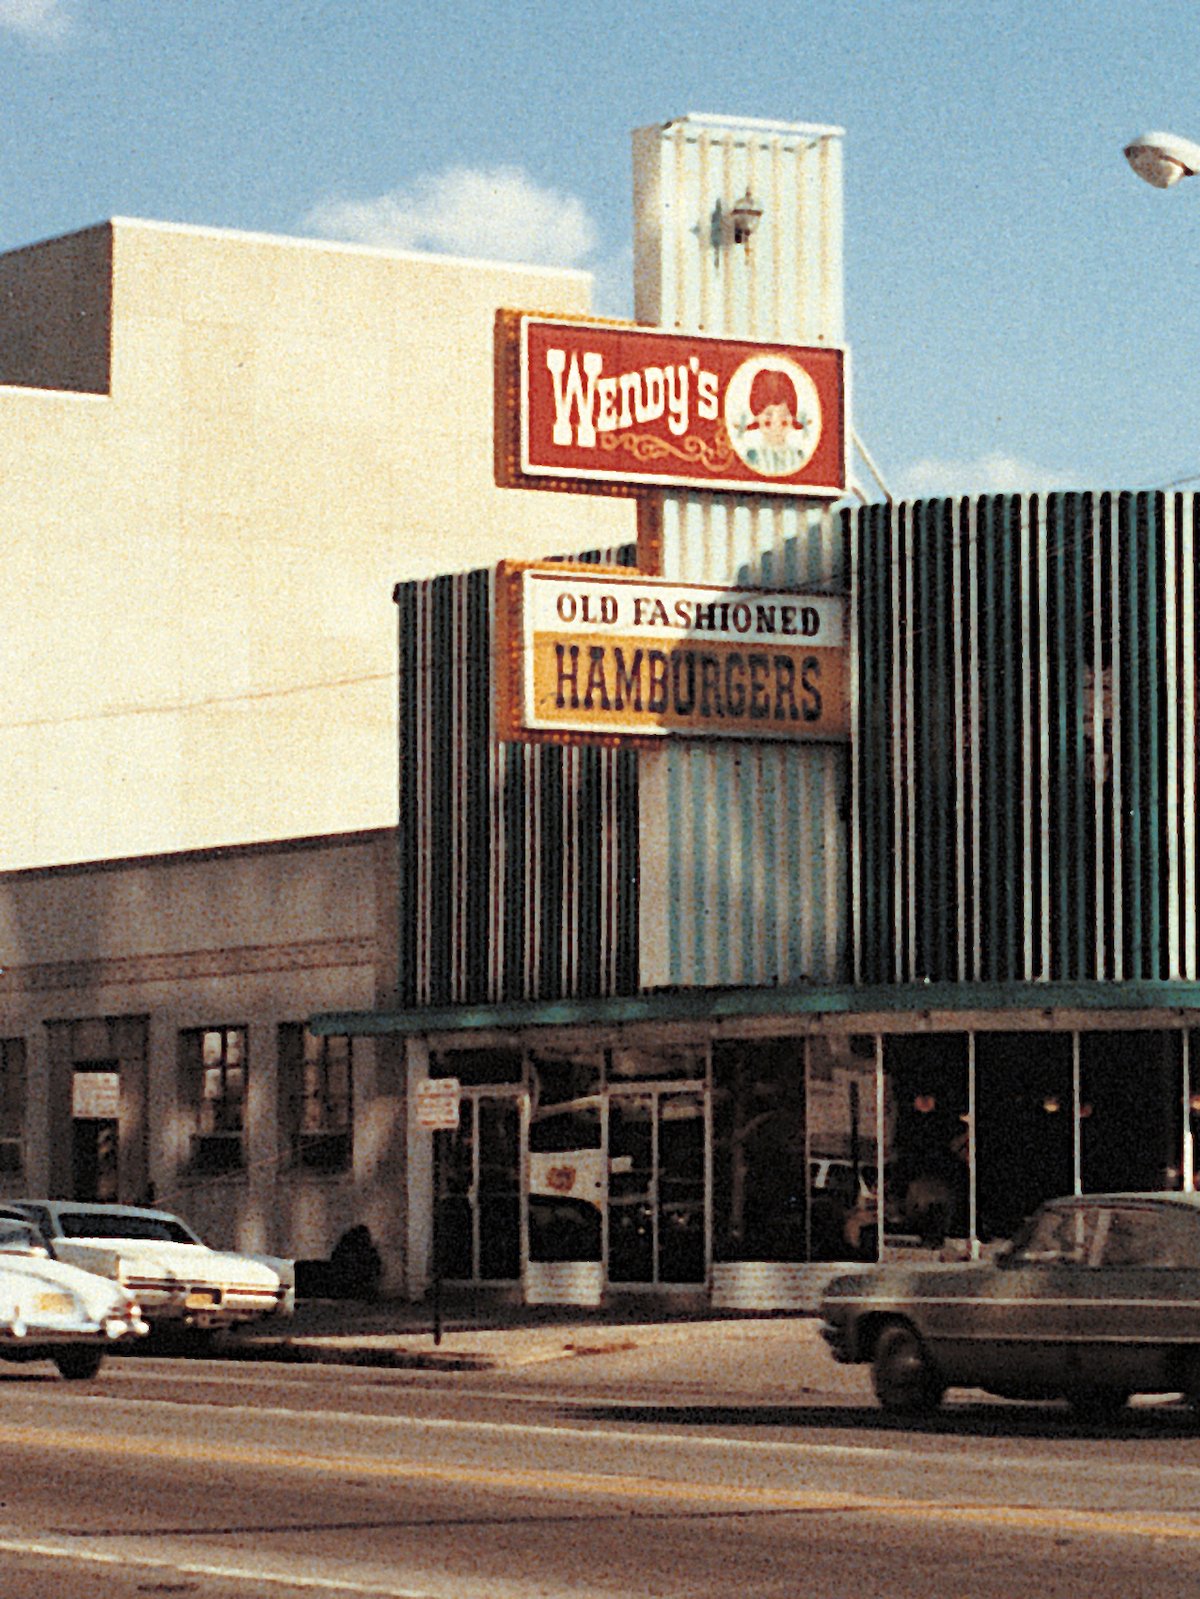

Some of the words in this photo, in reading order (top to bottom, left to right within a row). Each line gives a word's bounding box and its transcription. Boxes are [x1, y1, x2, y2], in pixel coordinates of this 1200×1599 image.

[556, 593, 619, 625] OLD
[633, 598, 821, 637] FASHIONED
[554, 644, 823, 723] HAMBURGERS
